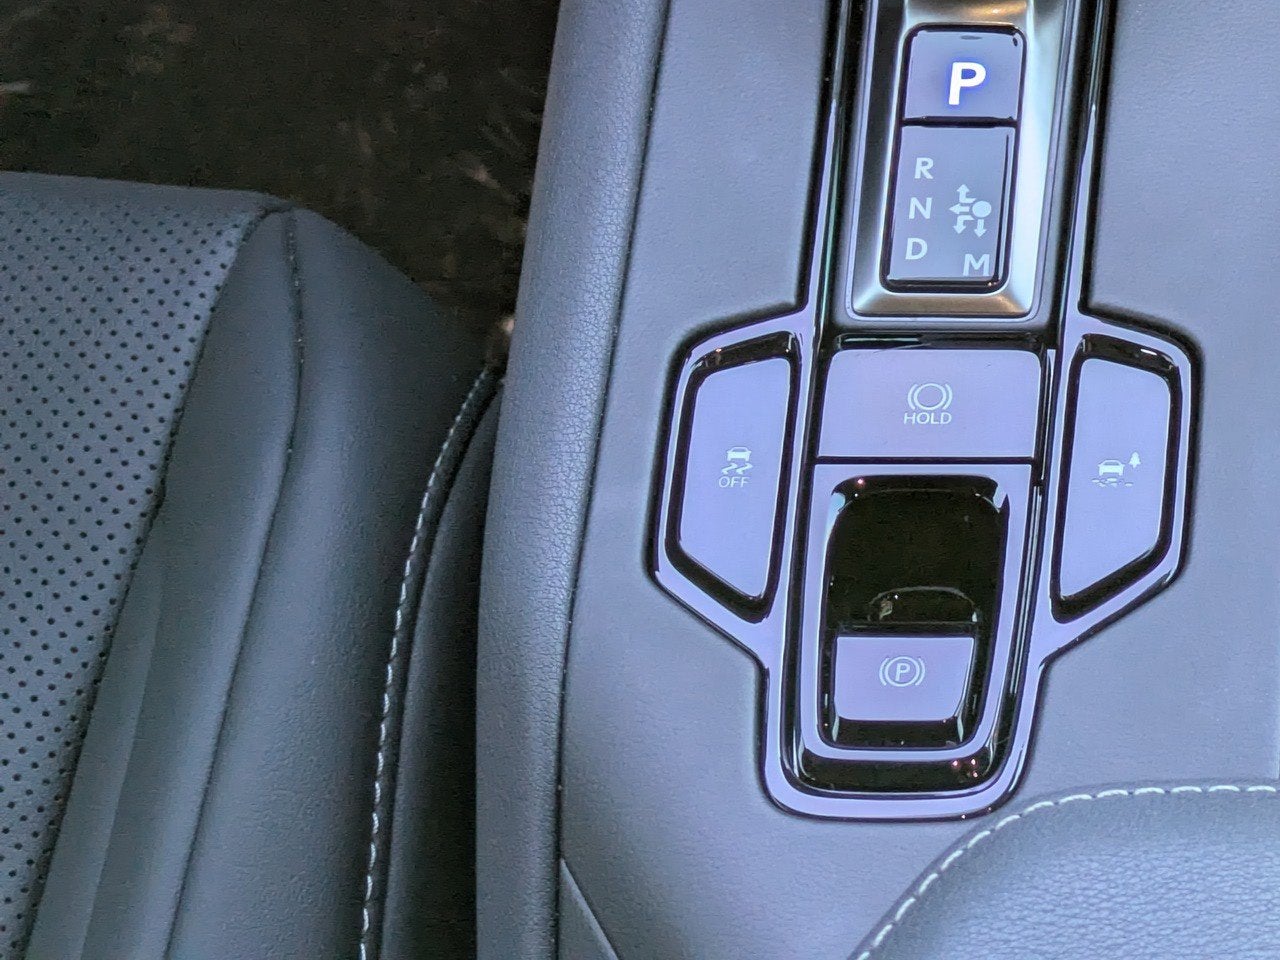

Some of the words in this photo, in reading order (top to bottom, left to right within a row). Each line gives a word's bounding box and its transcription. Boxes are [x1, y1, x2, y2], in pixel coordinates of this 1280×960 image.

[948, 61, 986, 105] P
[914, 157, 934, 180] R
[908, 197, 933, 220] N
[905, 237, 928, 261] D
[962, 253, 991, 277] M
[903, 412, 953, 426] HOLD
[718, 475, 750, 489] OFF
